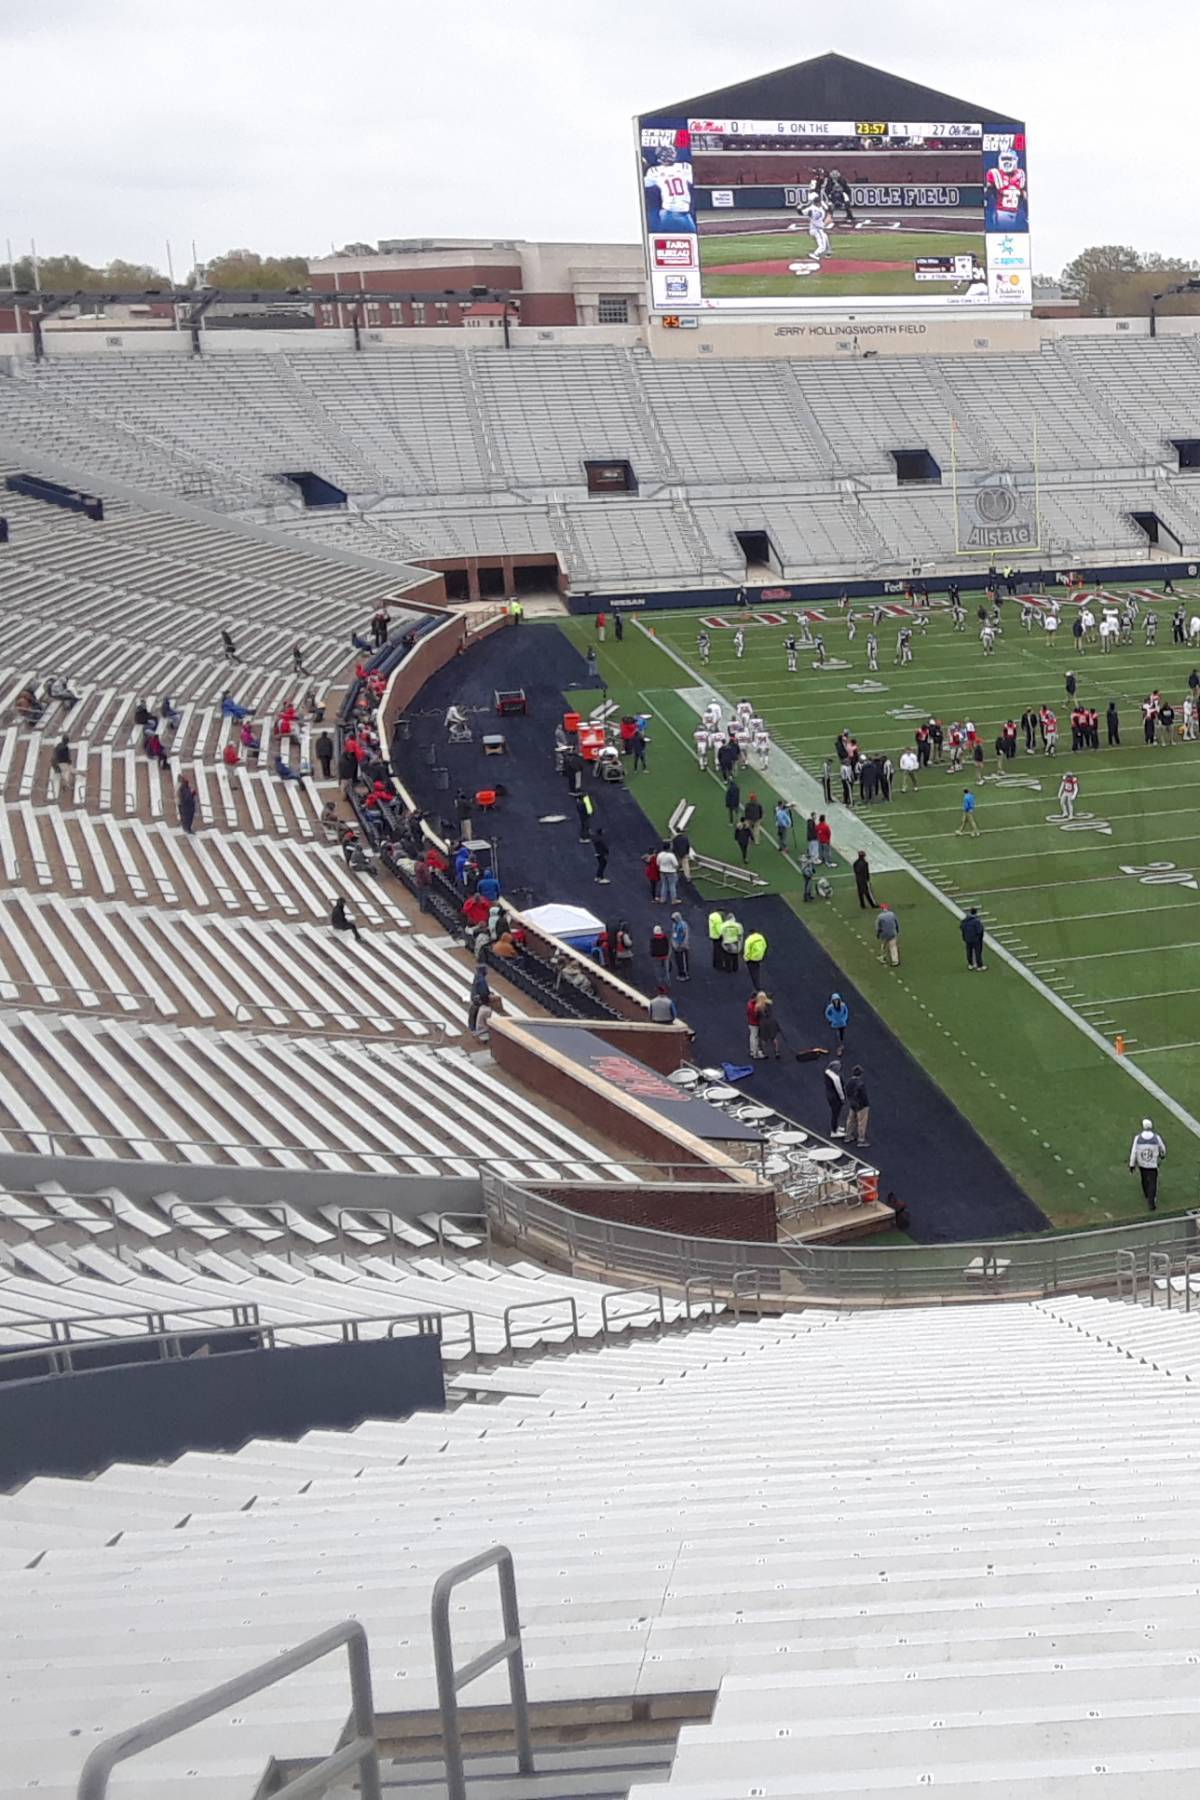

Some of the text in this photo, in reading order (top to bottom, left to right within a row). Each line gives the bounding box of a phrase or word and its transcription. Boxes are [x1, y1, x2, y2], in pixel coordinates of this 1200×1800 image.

[790, 123, 806, 133] ON
[808, 123, 829, 133] THE
[856, 123, 886, 135] 23:57
[932, 125, 945, 136] 27
[664, 177, 684, 196] 10
[904, 187, 960, 206] FIELD
[663, 316, 679, 328] 25
[774, 325, 927, 336] JERRY HOLLINGSWORTH FIELD
[968, 527, 1030, 545] Allstate
[1118, 861, 1195, 885] 20
